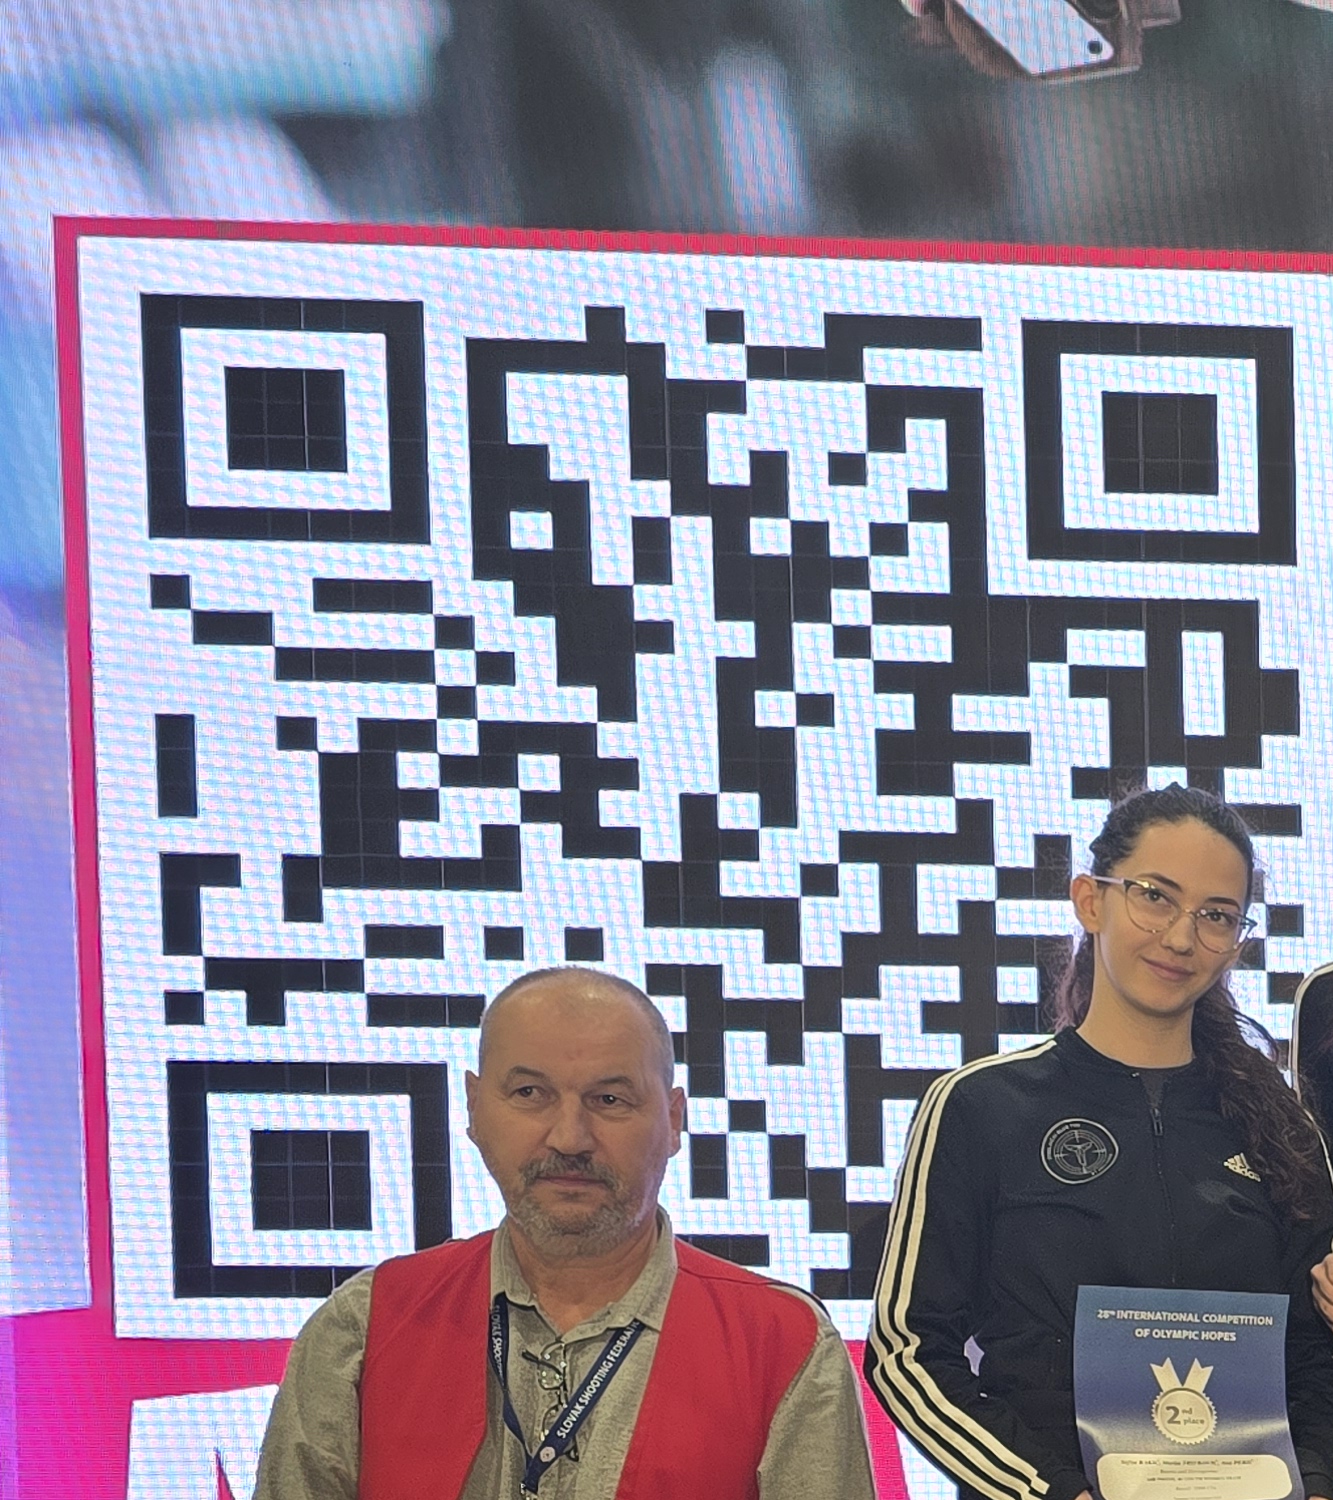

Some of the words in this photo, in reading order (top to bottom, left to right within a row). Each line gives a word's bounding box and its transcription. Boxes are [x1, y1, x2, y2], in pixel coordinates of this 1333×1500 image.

[1117, 1310, 1200, 1323] INTERNATIONAL
[1203, 1314, 1273, 1326] COMPETITION
[1135, 1328, 1150, 1338] OF
[1152, 1329, 1199, 1340] OLYMPIC
[1201, 1331, 1236, 1342] HOPES
[557, 1402, 585, 1439] SLOVAK
[579, 1361, 613, 1407] SHOOTING
[1183, 1417, 1205, 1426] place
